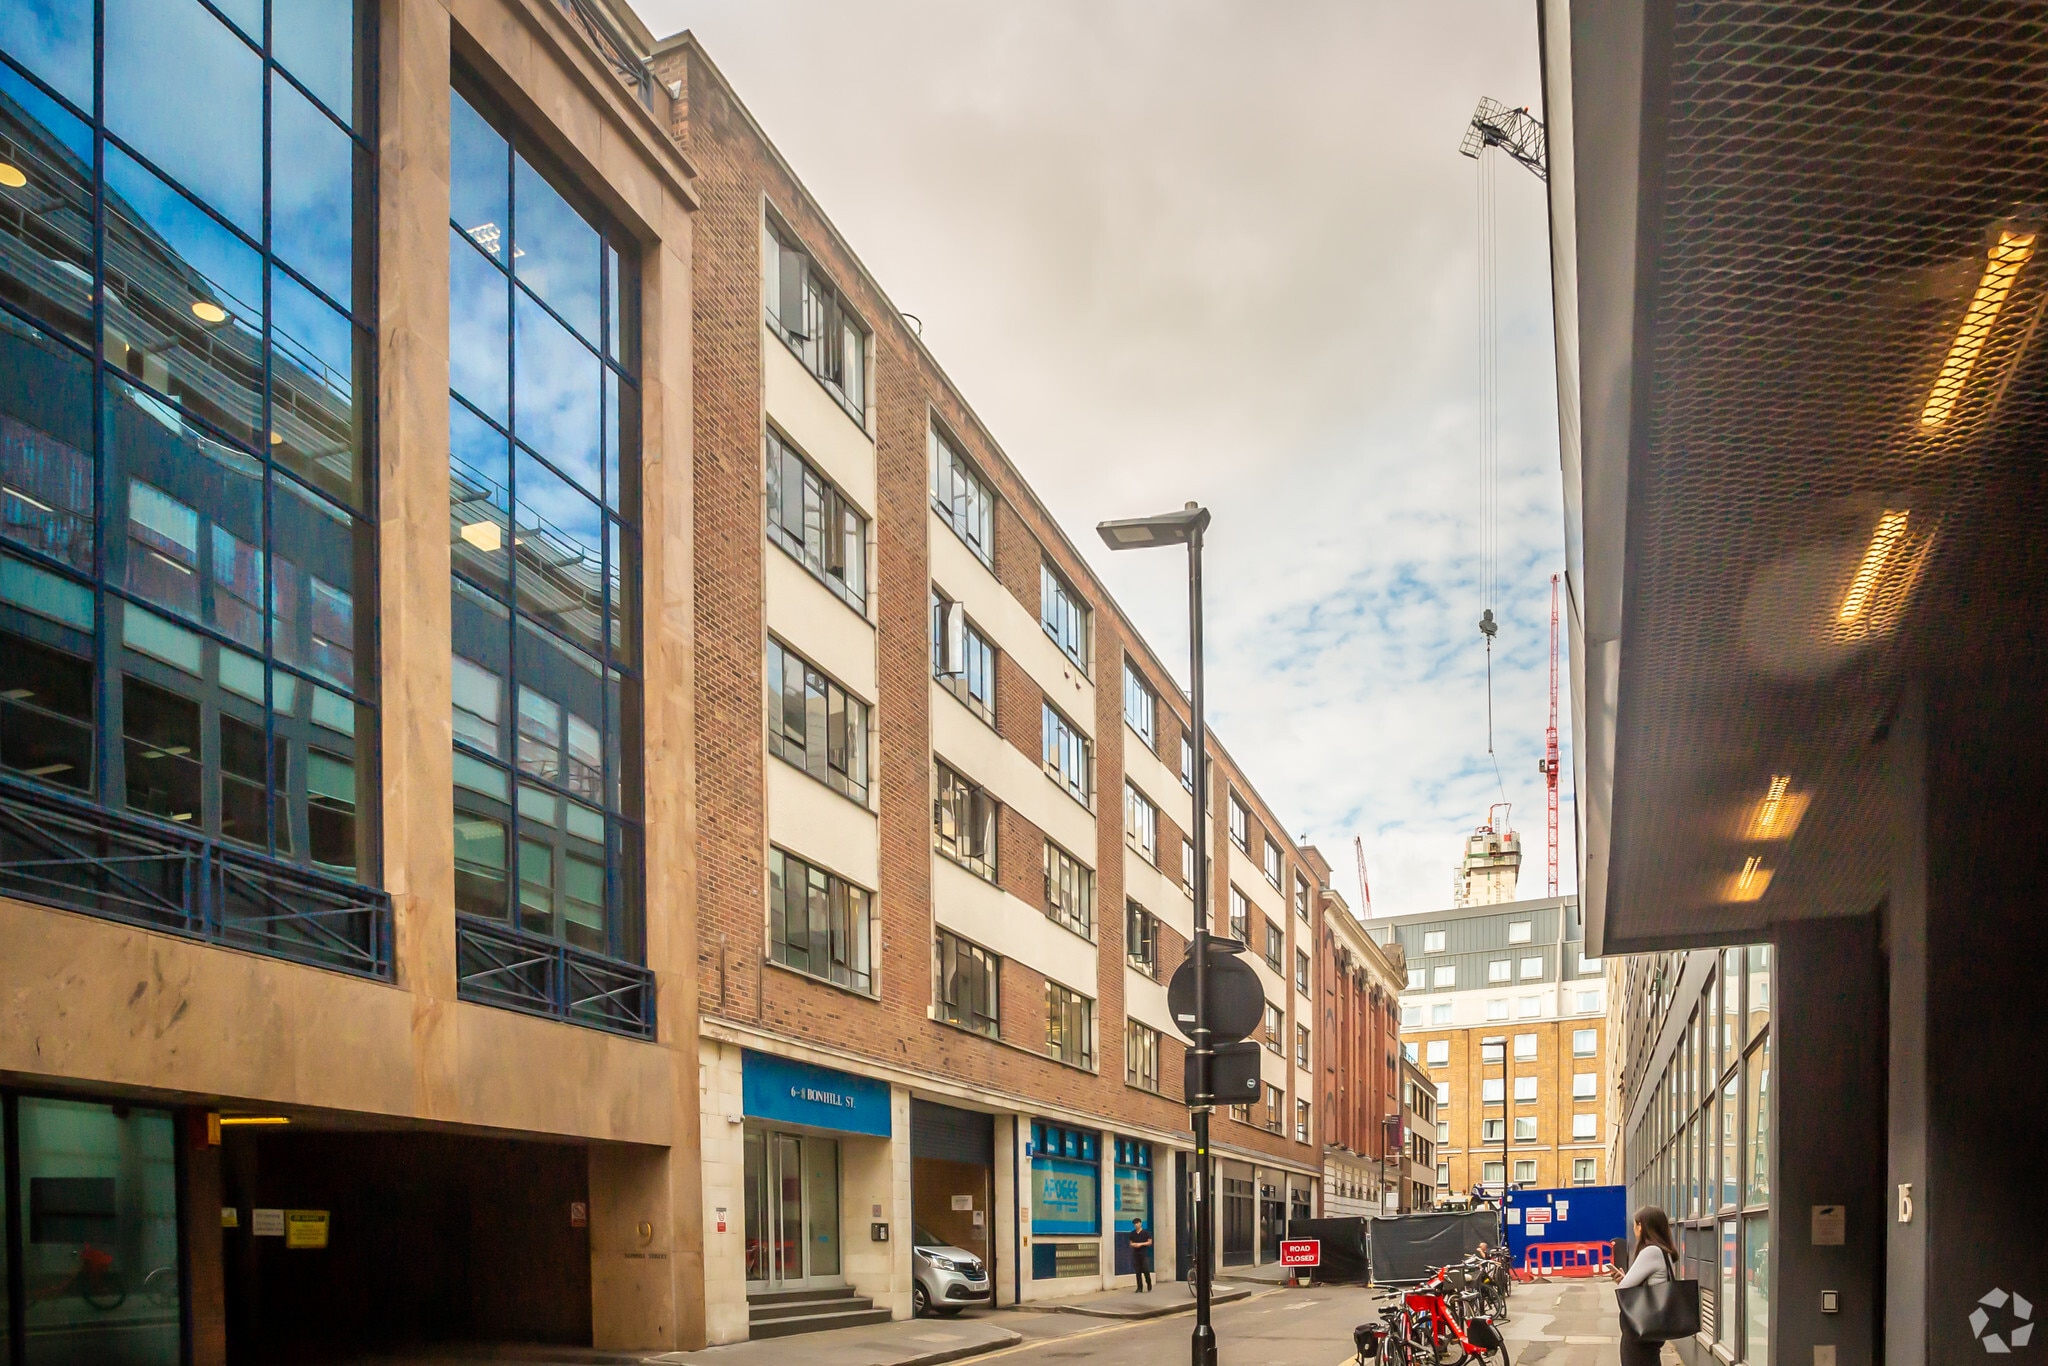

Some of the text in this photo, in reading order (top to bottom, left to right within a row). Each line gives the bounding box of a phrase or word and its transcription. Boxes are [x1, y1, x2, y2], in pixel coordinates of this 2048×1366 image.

[807, 1088, 842, 1107] BONHILL
[1043, 1178, 1079, 1199] APOGEE
[636, 1220, 653, 1248] 9
